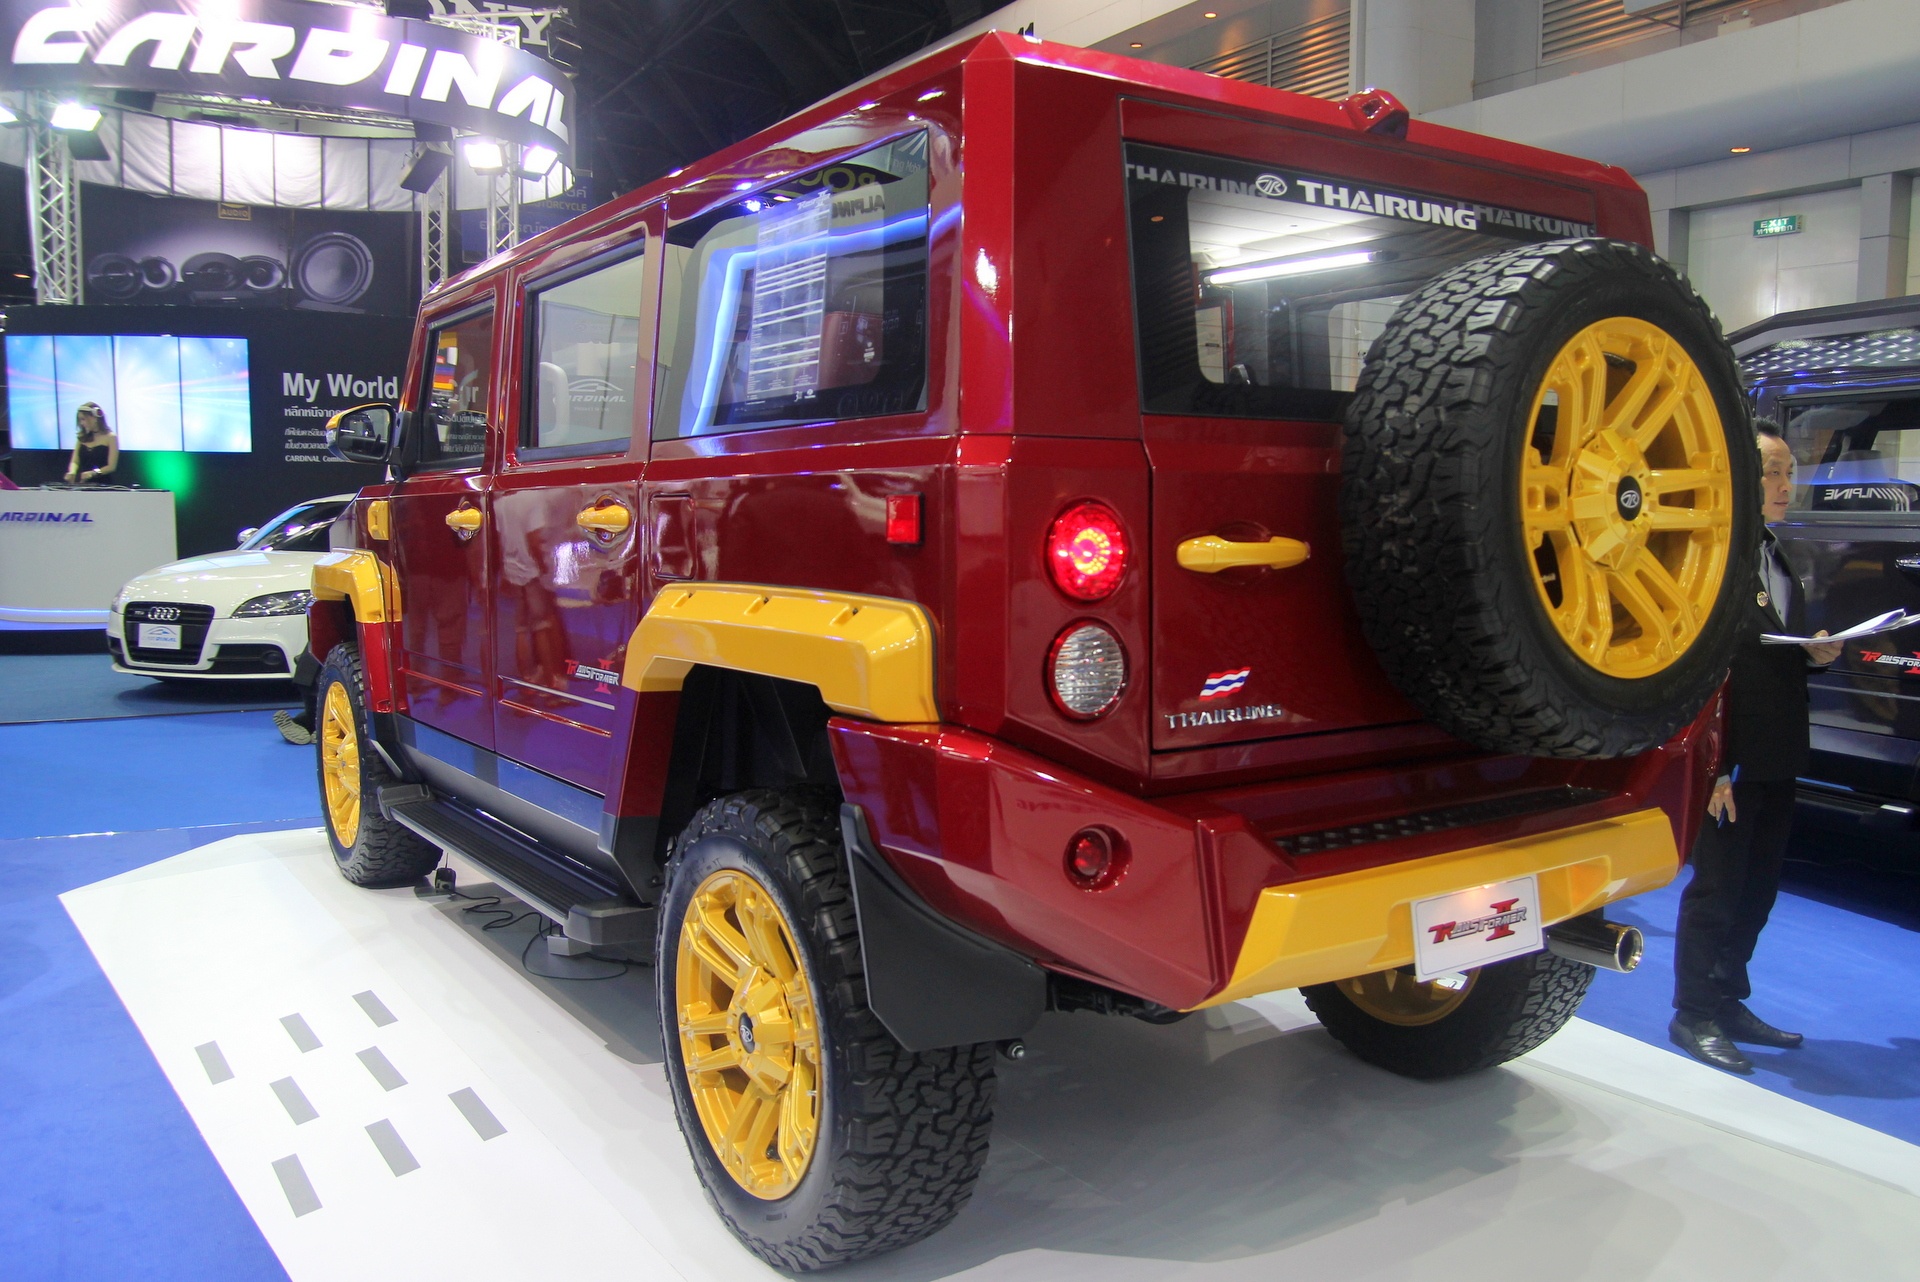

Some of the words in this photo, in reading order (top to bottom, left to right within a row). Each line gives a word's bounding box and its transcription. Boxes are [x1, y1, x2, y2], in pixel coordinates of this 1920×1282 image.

[11, 6, 569, 146] CARDINAL
[532, 200, 588, 212] OTORCYCLE
[1296, 179, 1477, 231] THAIRUNG
[220, 208, 249, 218] AUDIO
[1760, 217, 1790, 229] EXIT
[282, 372, 320, 403] My
[326, 373, 399, 399] World
[569, 394, 626, 403] RDINAL
[284, 455, 321, 463] CARDINAL
[0, 511, 94, 523] ARDINAL
[1859, 650, 1920, 668] TRANSFOR
[1164, 703, 1283, 729] THAIRUNG
